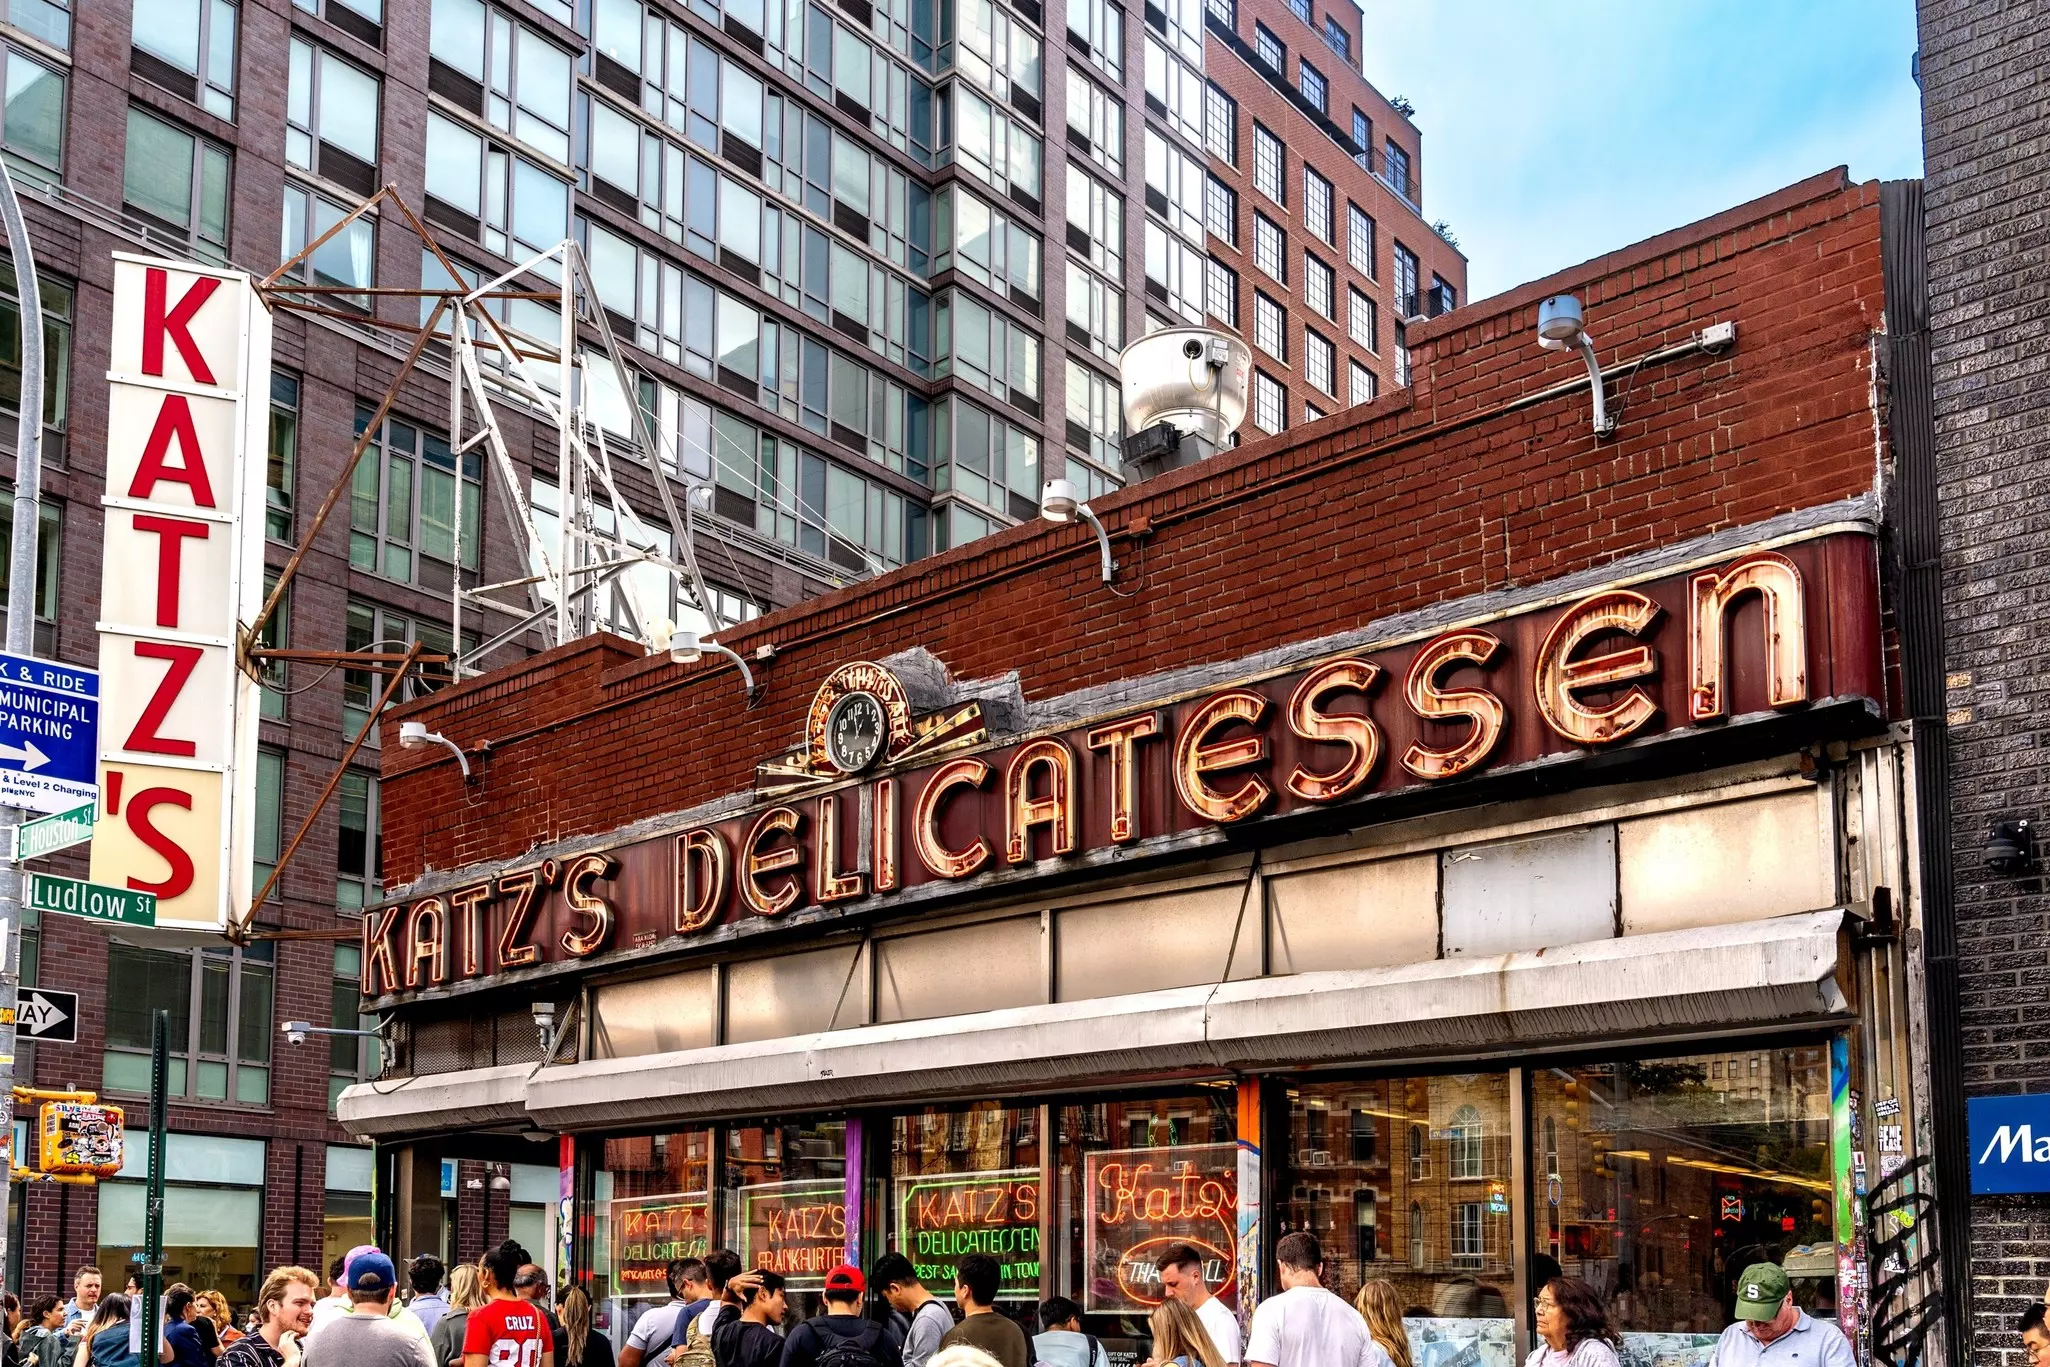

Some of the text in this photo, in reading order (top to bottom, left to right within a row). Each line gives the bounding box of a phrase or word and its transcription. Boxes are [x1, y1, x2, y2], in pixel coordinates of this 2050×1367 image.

[106, 267, 222, 901] KATZ'S
[20, 666, 33, 682] &
[43, 670, 86, 692] RIDE
[0, 689, 91, 723] MUNICIPAL
[847, 708, 853, 721] 11
[854, 703, 862, 715] 12
[0, 711, 72, 740] PARKING
[840, 719, 847, 731] 10
[3, 775, 97, 799] & Level 2 Charging
[21, 807, 92, 855] E Houston St
[33, 878, 151, 918] Ludlow St
[362, 852, 612, 995] KATZ'S
[17, 1004, 52, 1023] AY
[919, 1181, 1037, 1229] KATZ'S
[768, 1201, 845, 1242] KATZ'S
[1000, 1264, 1012, 1280] IN
[1747, 1283, 1759, 1299] S
[505, 1316, 535, 1330] CRUZ
